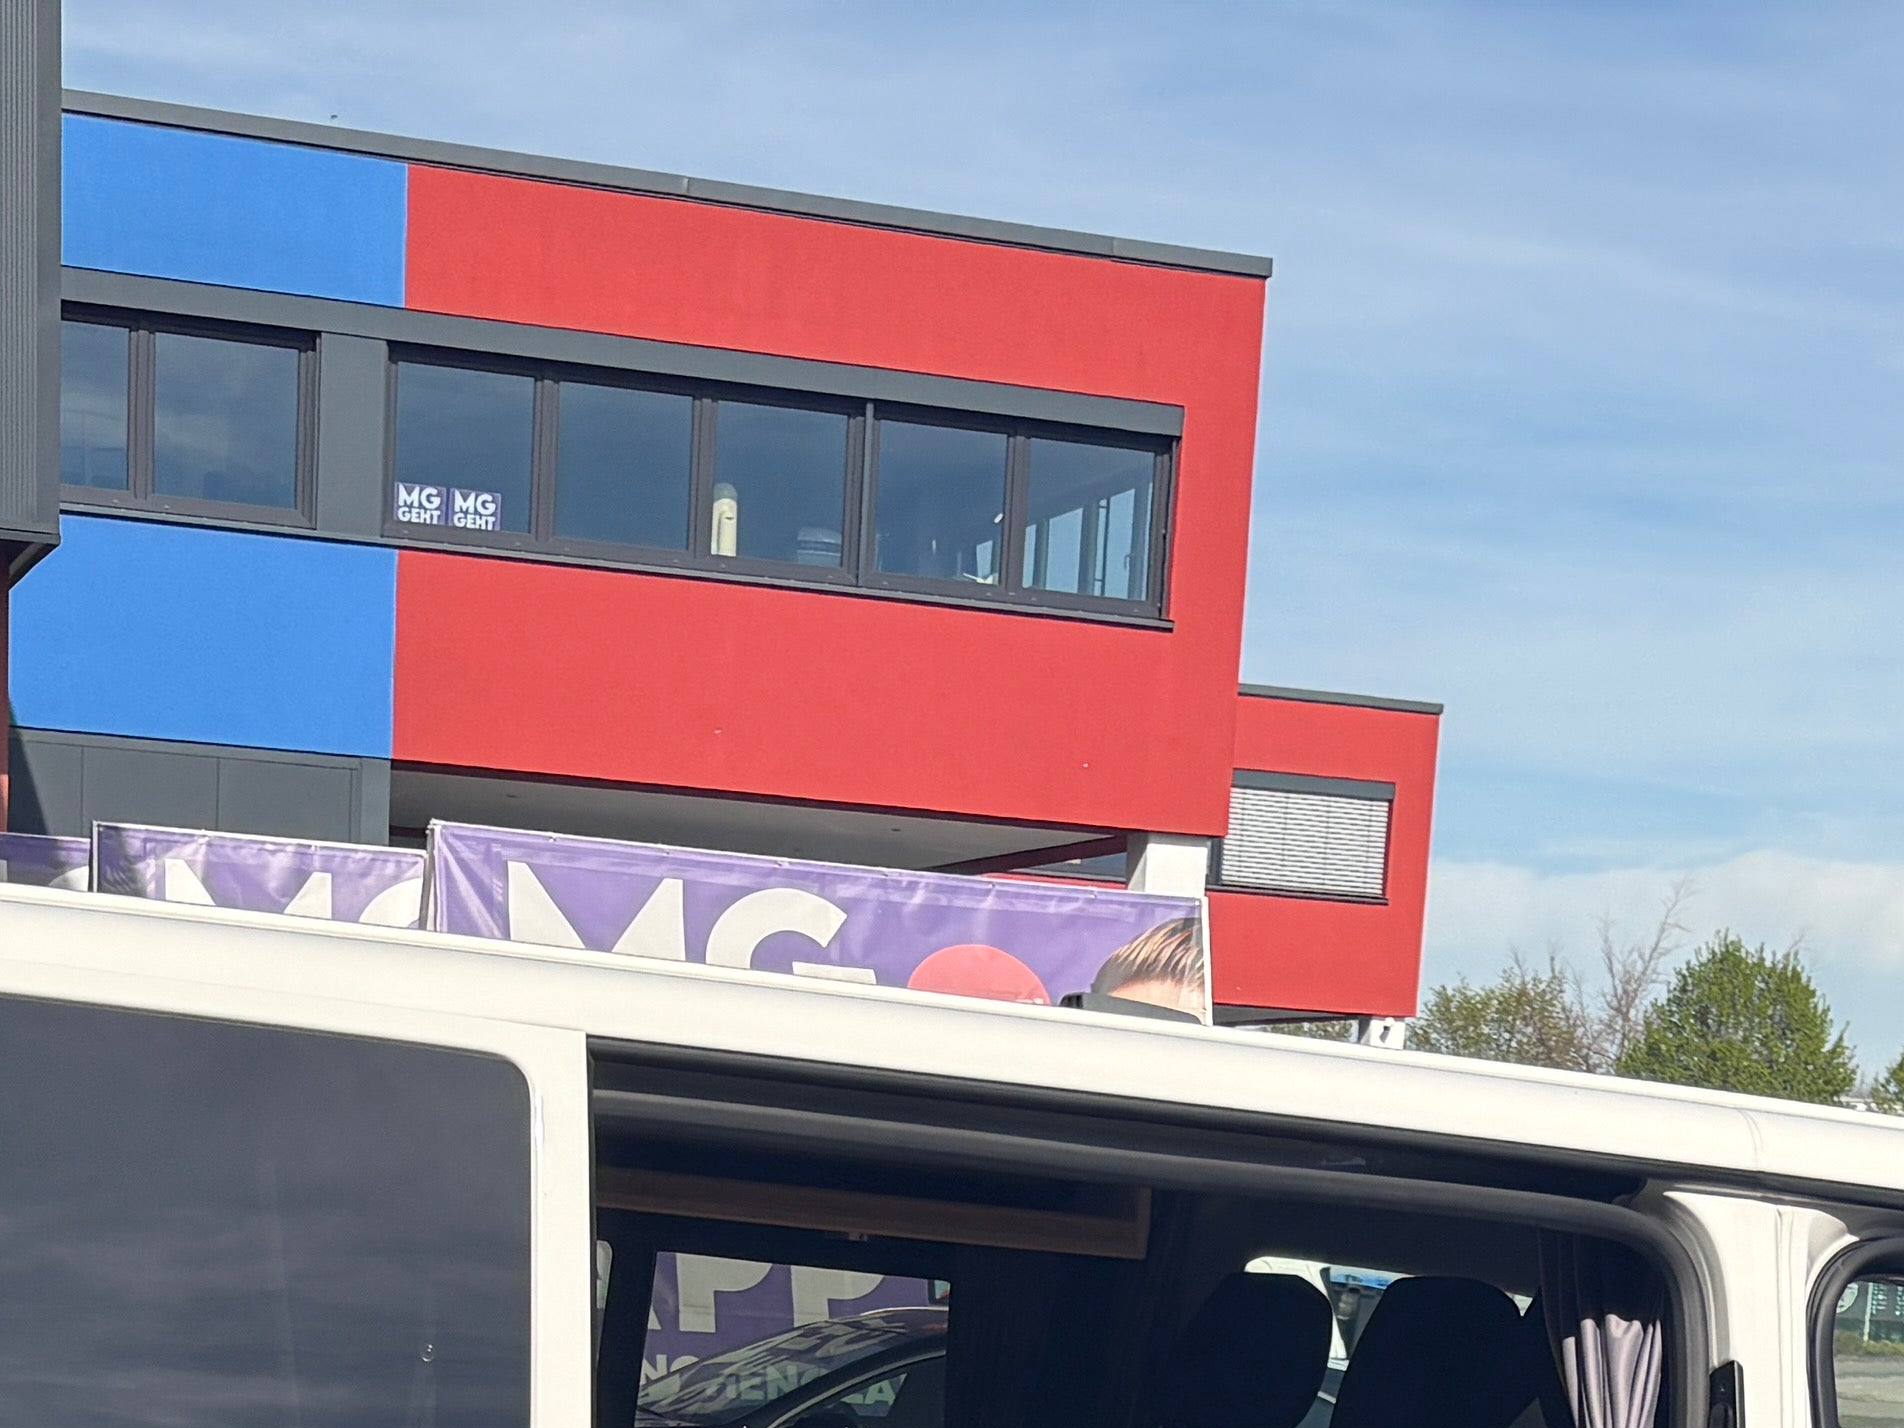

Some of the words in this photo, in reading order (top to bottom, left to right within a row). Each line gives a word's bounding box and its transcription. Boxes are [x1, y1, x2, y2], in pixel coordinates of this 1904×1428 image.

[398, 484, 441, 509] MG
[454, 490, 496, 515] MG
[398, 507, 441, 524] GEHT
[453, 513, 496, 531] GEHT
